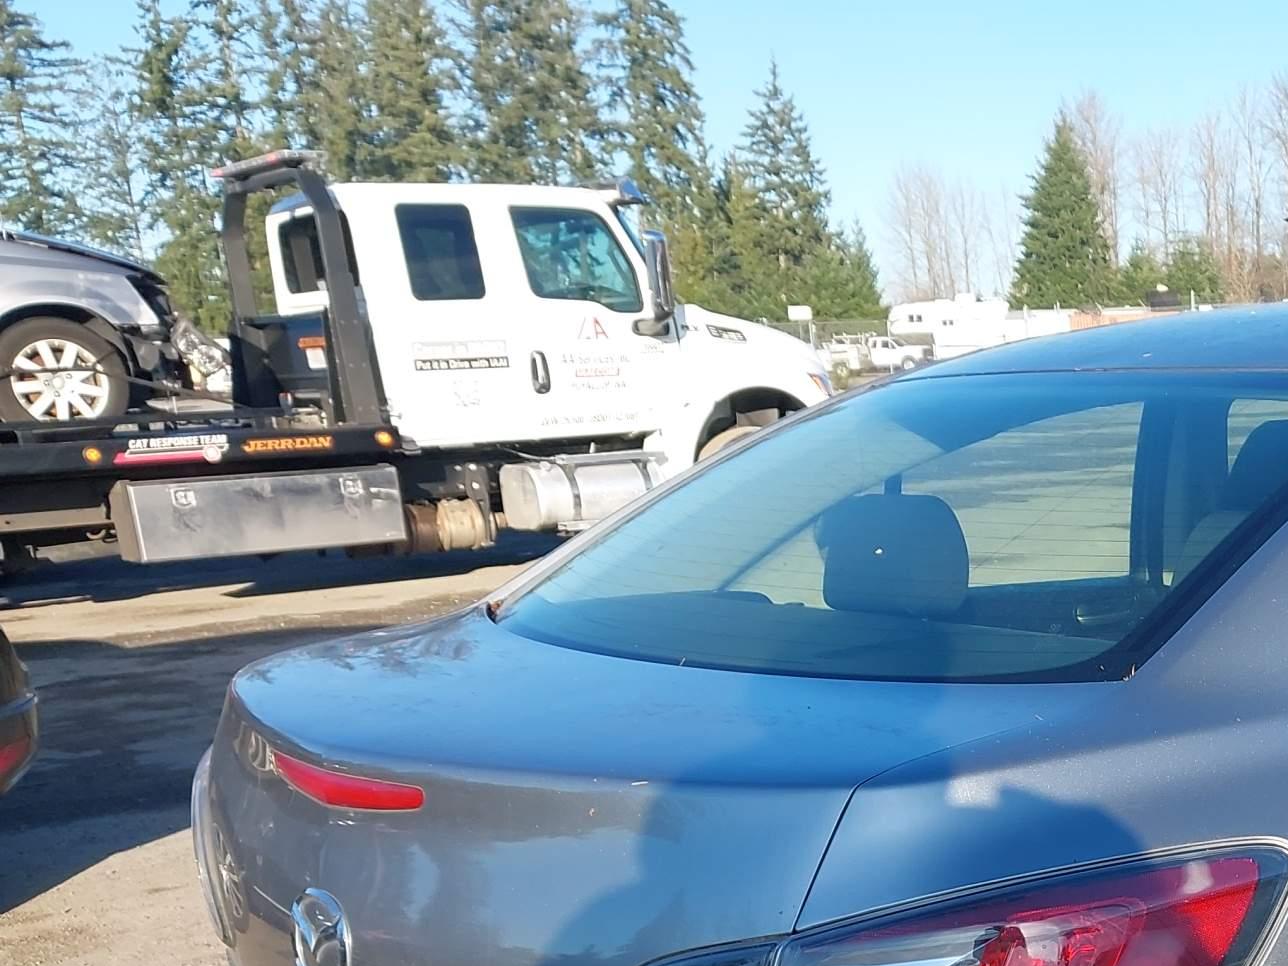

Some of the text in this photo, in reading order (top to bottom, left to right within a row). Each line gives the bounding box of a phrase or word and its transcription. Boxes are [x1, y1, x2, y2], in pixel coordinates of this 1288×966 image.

[416, 360, 431, 370] Put
[128, 434, 227, 449] CAT RESPONSE TEAM
